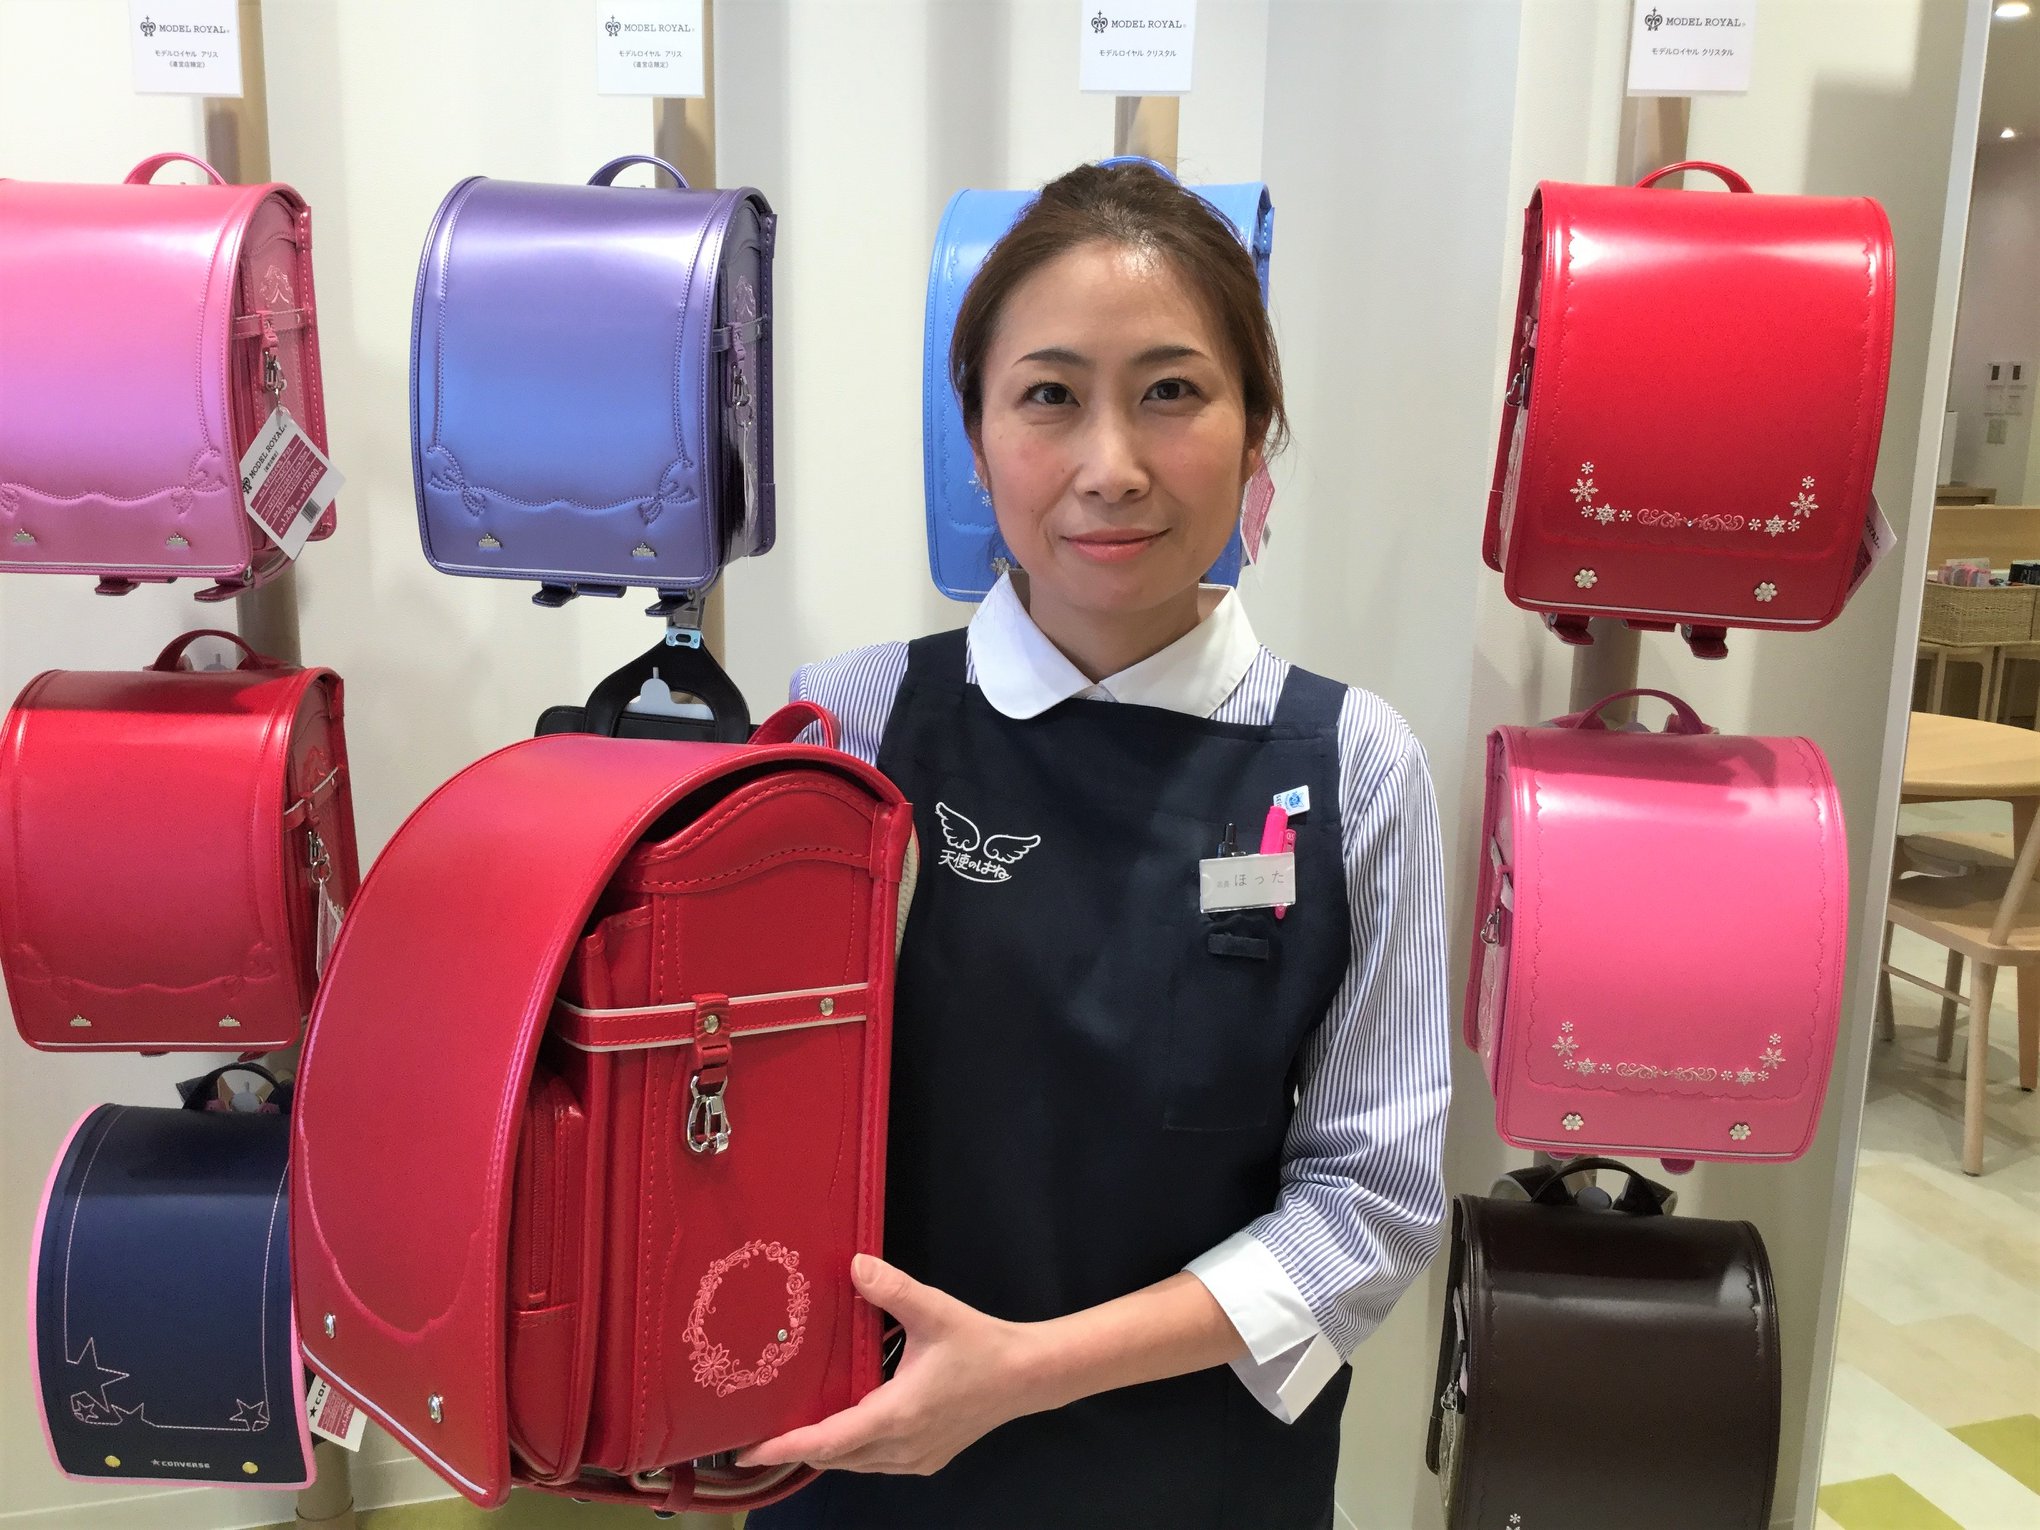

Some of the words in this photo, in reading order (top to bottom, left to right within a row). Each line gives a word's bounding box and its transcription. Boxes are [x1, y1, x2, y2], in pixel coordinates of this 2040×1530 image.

[1111, 20, 1145, 28] MODEL
[1665, 17, 1703, 26] MODEL
[159, 24, 191, 33] MODEL
[624, 24, 656, 32] MODEL
[249, 450, 269, 479] MODEL
